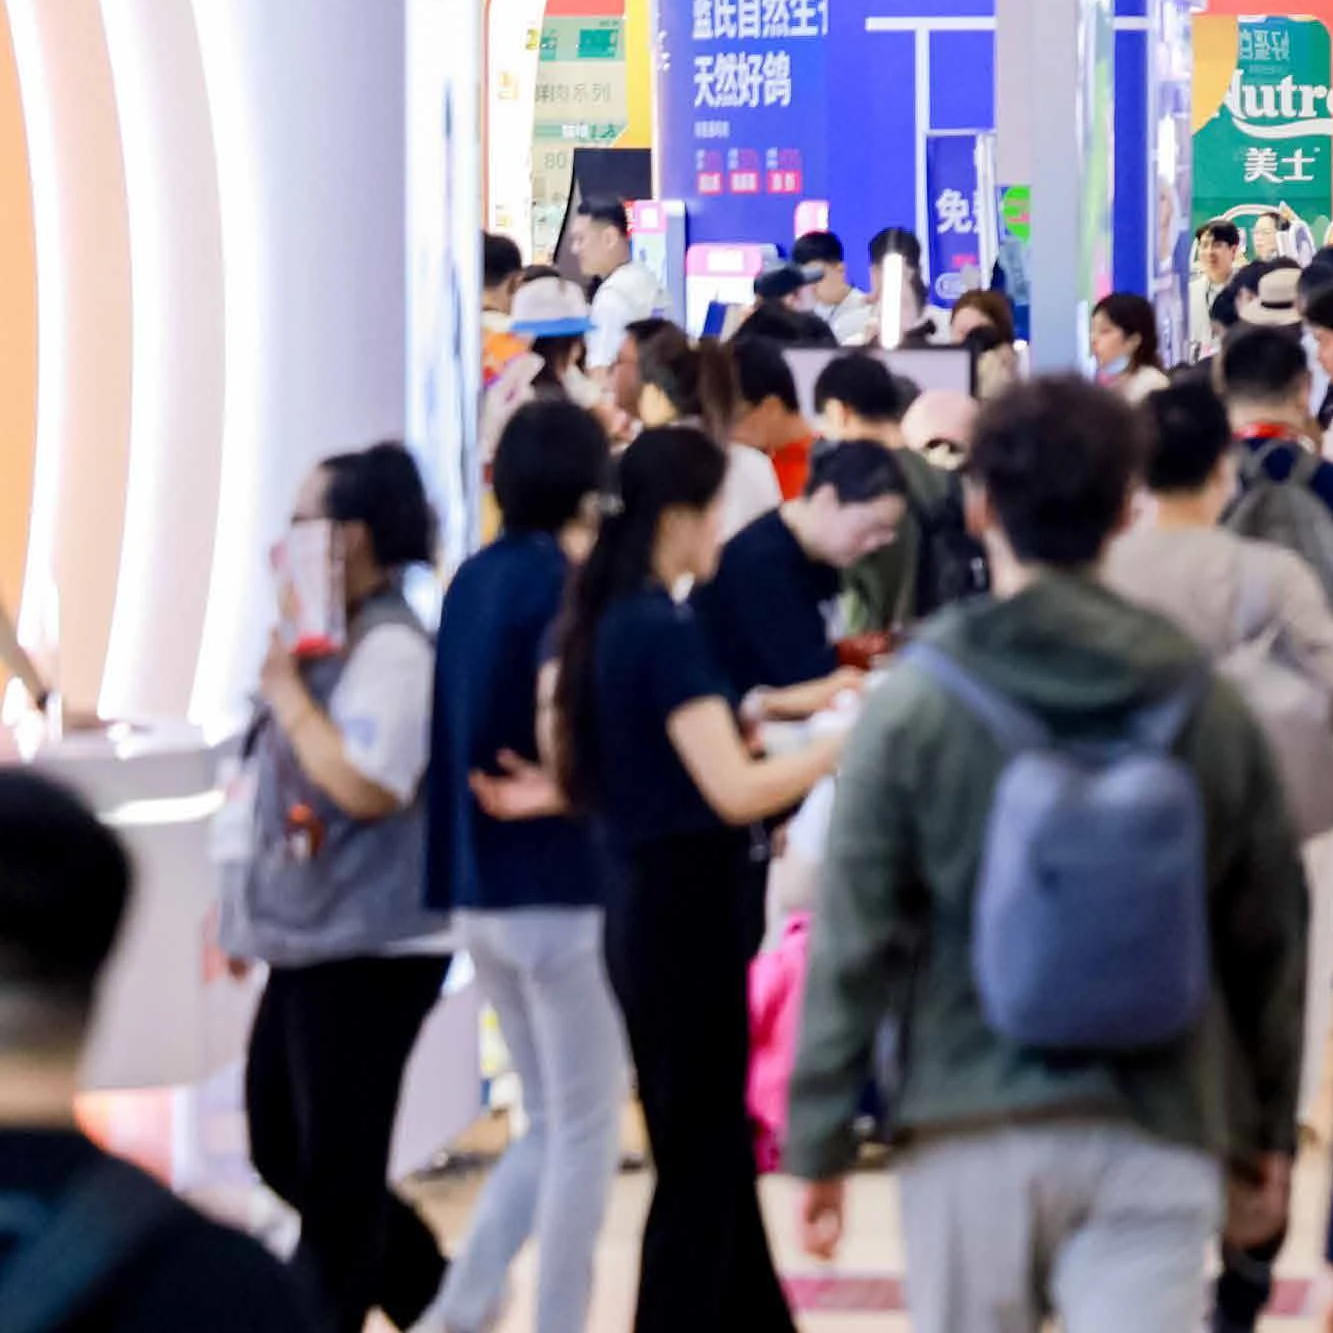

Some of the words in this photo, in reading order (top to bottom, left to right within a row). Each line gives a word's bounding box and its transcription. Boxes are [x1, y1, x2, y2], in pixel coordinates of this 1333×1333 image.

[693, 51, 791, 109] 天然好鸽
[1224, 69, 1333, 120] utr
[1244, 147, 1315, 184] 美士
[936, 188, 979, 235] 免
